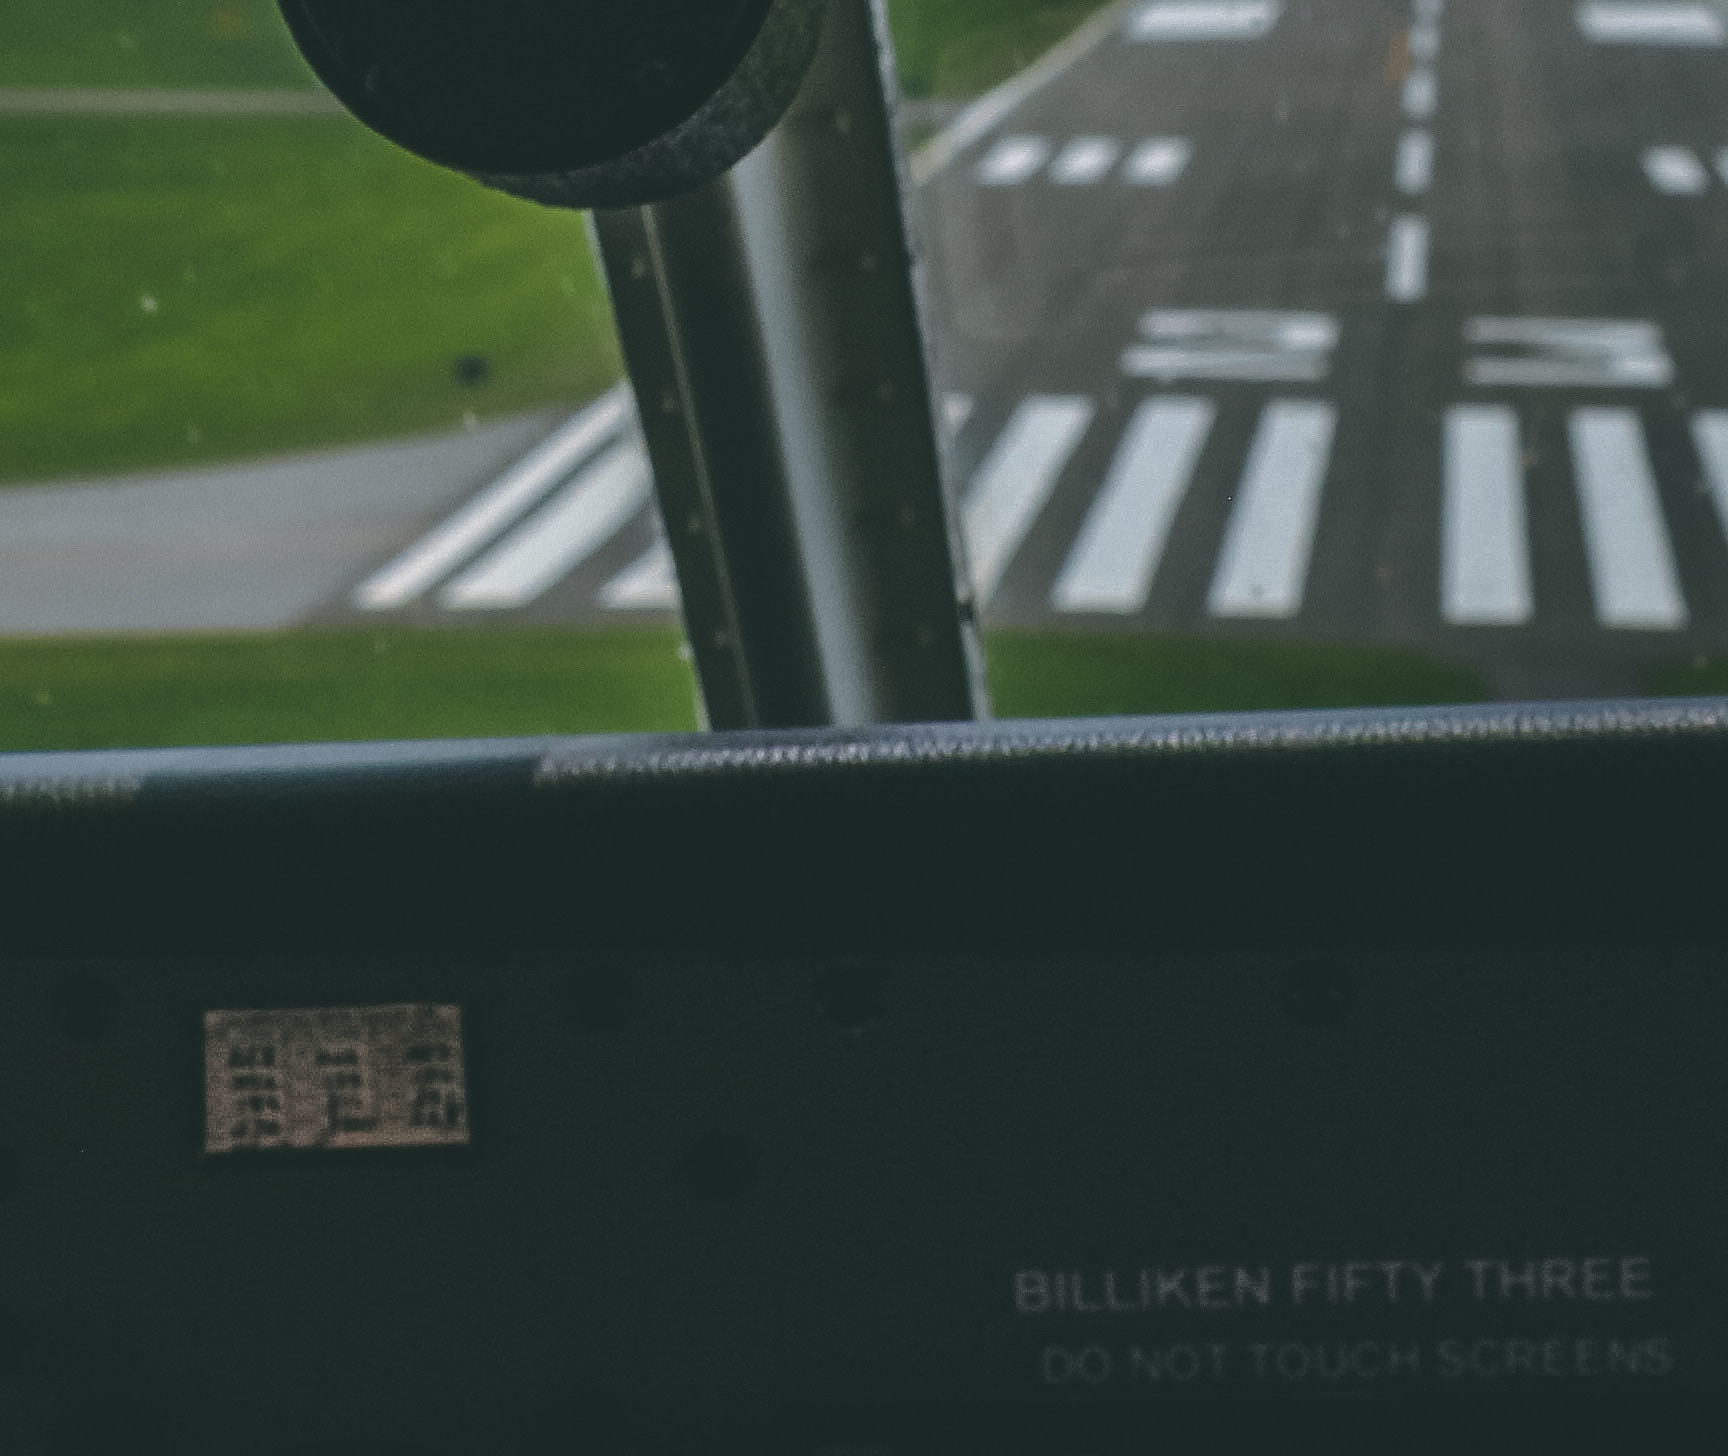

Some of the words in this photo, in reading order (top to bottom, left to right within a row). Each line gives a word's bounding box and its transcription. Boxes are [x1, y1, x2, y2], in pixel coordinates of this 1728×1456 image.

[1013, 1264, 1272, 1315] BILLIKEN
[1290, 1258, 1445, 1305] FIFTY
[1462, 1253, 1656, 1302] THREE
[1039, 1344, 1113, 1385] DO
[1128, 1342, 1229, 1384] NOT
[1246, 1338, 1421, 1382] TOUCH
[1434, 1334, 1676, 1378] SCREENS
